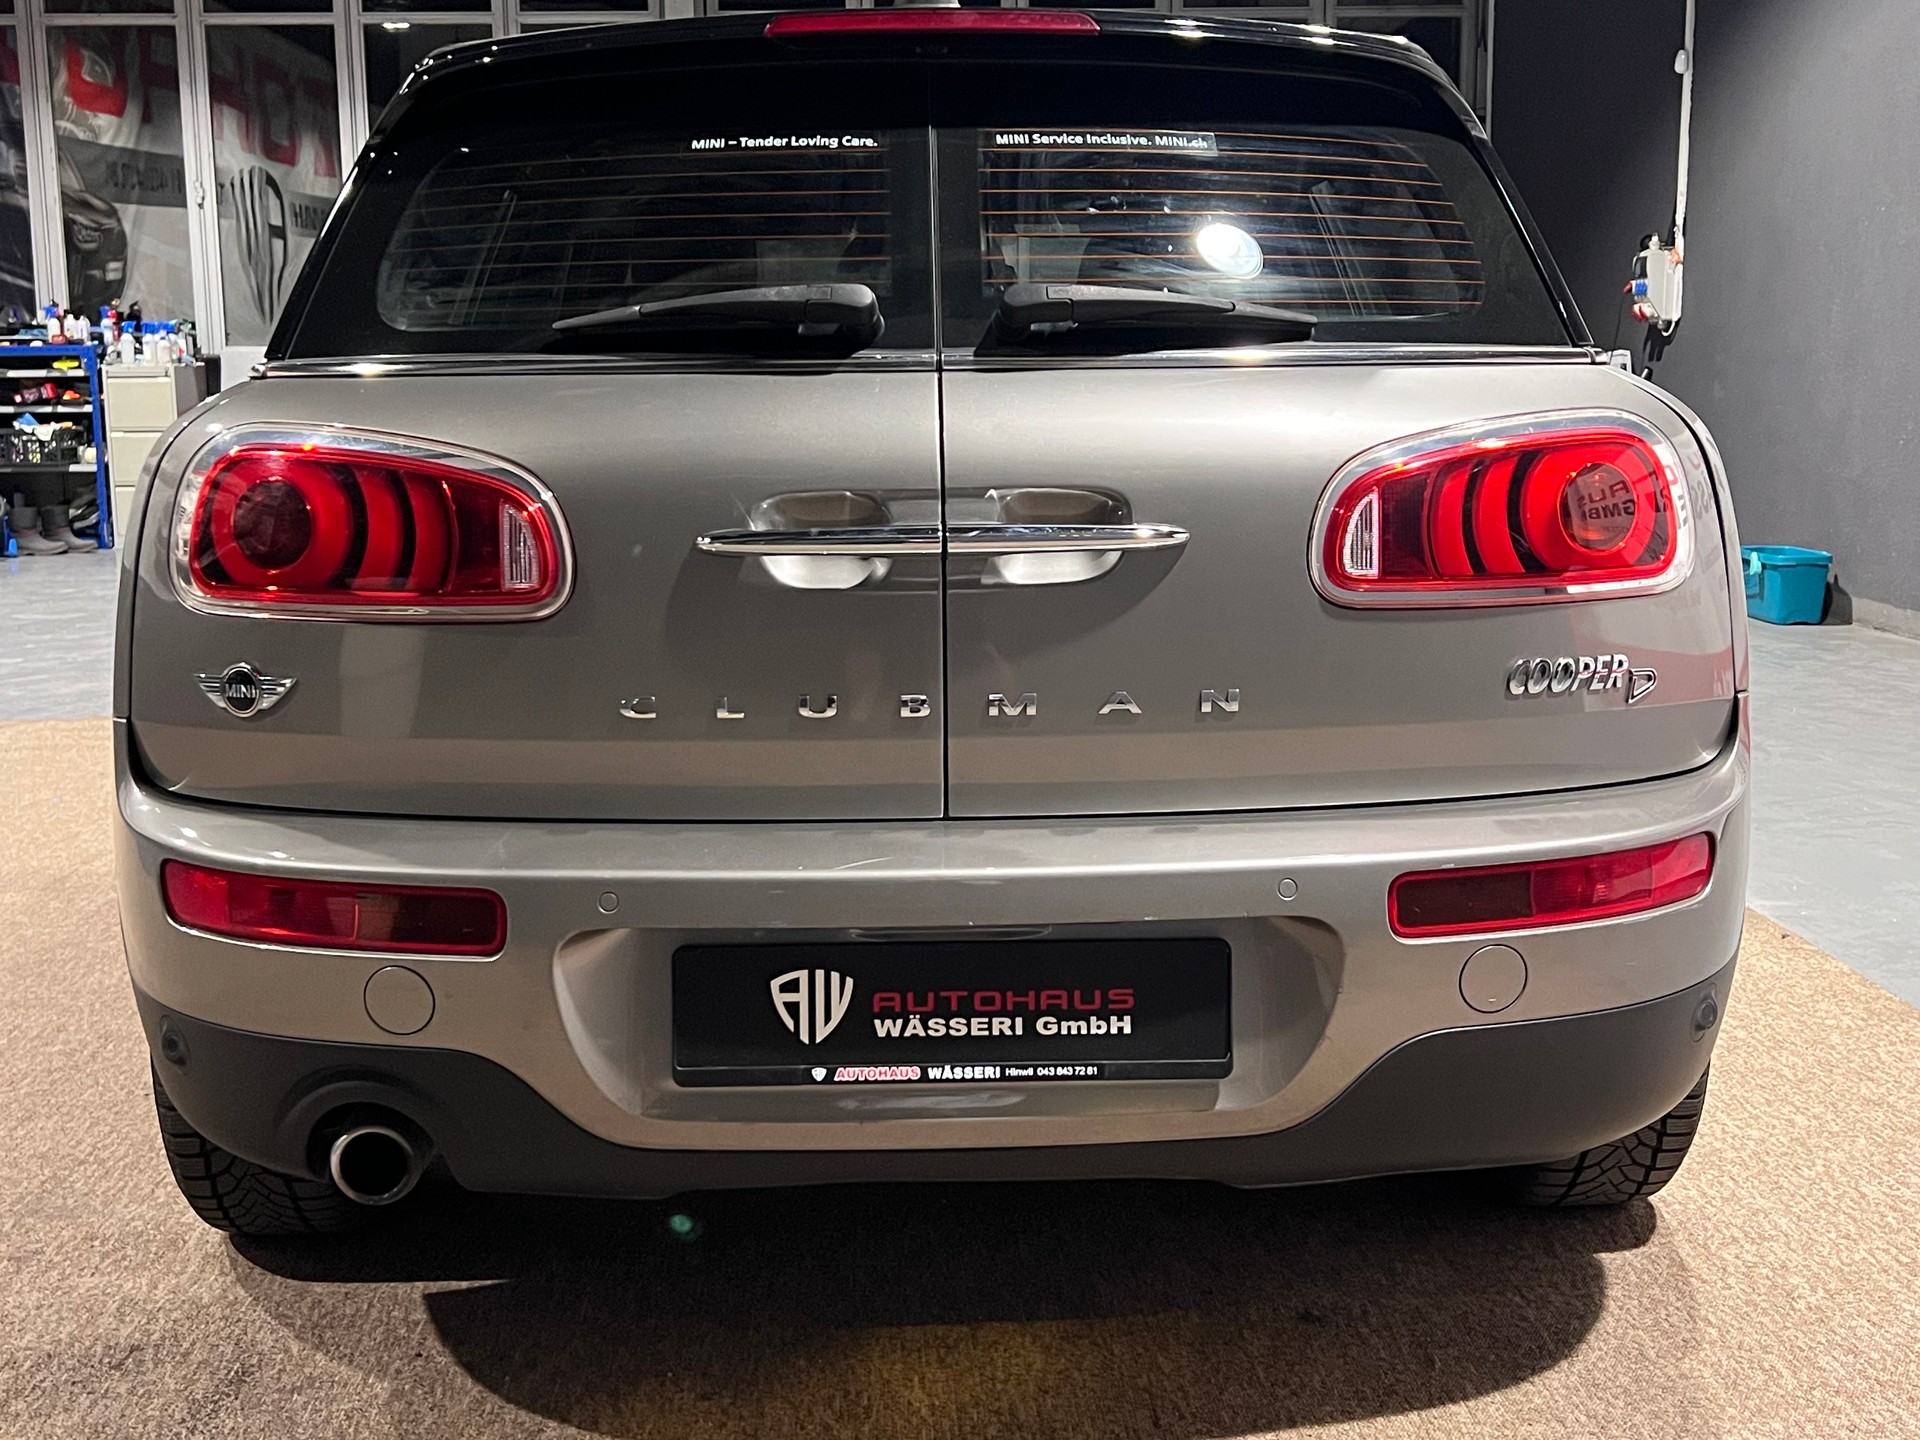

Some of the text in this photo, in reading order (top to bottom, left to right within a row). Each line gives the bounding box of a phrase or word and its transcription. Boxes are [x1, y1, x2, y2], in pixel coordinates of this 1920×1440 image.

[691, 138, 726, 150] MINI
[739, 136, 789, 148] Tender
[791, 135, 839, 149] Loving
[841, 135, 878, 147] Care.
[995, 133, 1029, 145] MINI
[1032, 133, 1083, 145] Service
[1086, 133, 1152, 146] Inclusive.
[1508, 653, 1657, 704] COOPER D
[225, 683, 257, 699] MINI
[619, 688, 1240, 719] CLUBMAN
[872, 988, 1135, 1013] AUTOHAUS
[873, 1015, 1132, 1037] WÄSSERI GmbH
[833, 1065, 921, 1081] AUTOHAUS
[927, 1064, 1000, 1079] WÄSSERI
[1005, 1066, 1034, 1077] Hinwil
[1037, 1066, 1055, 1076] 043
[1074, 1066, 1086, 1076] 72
